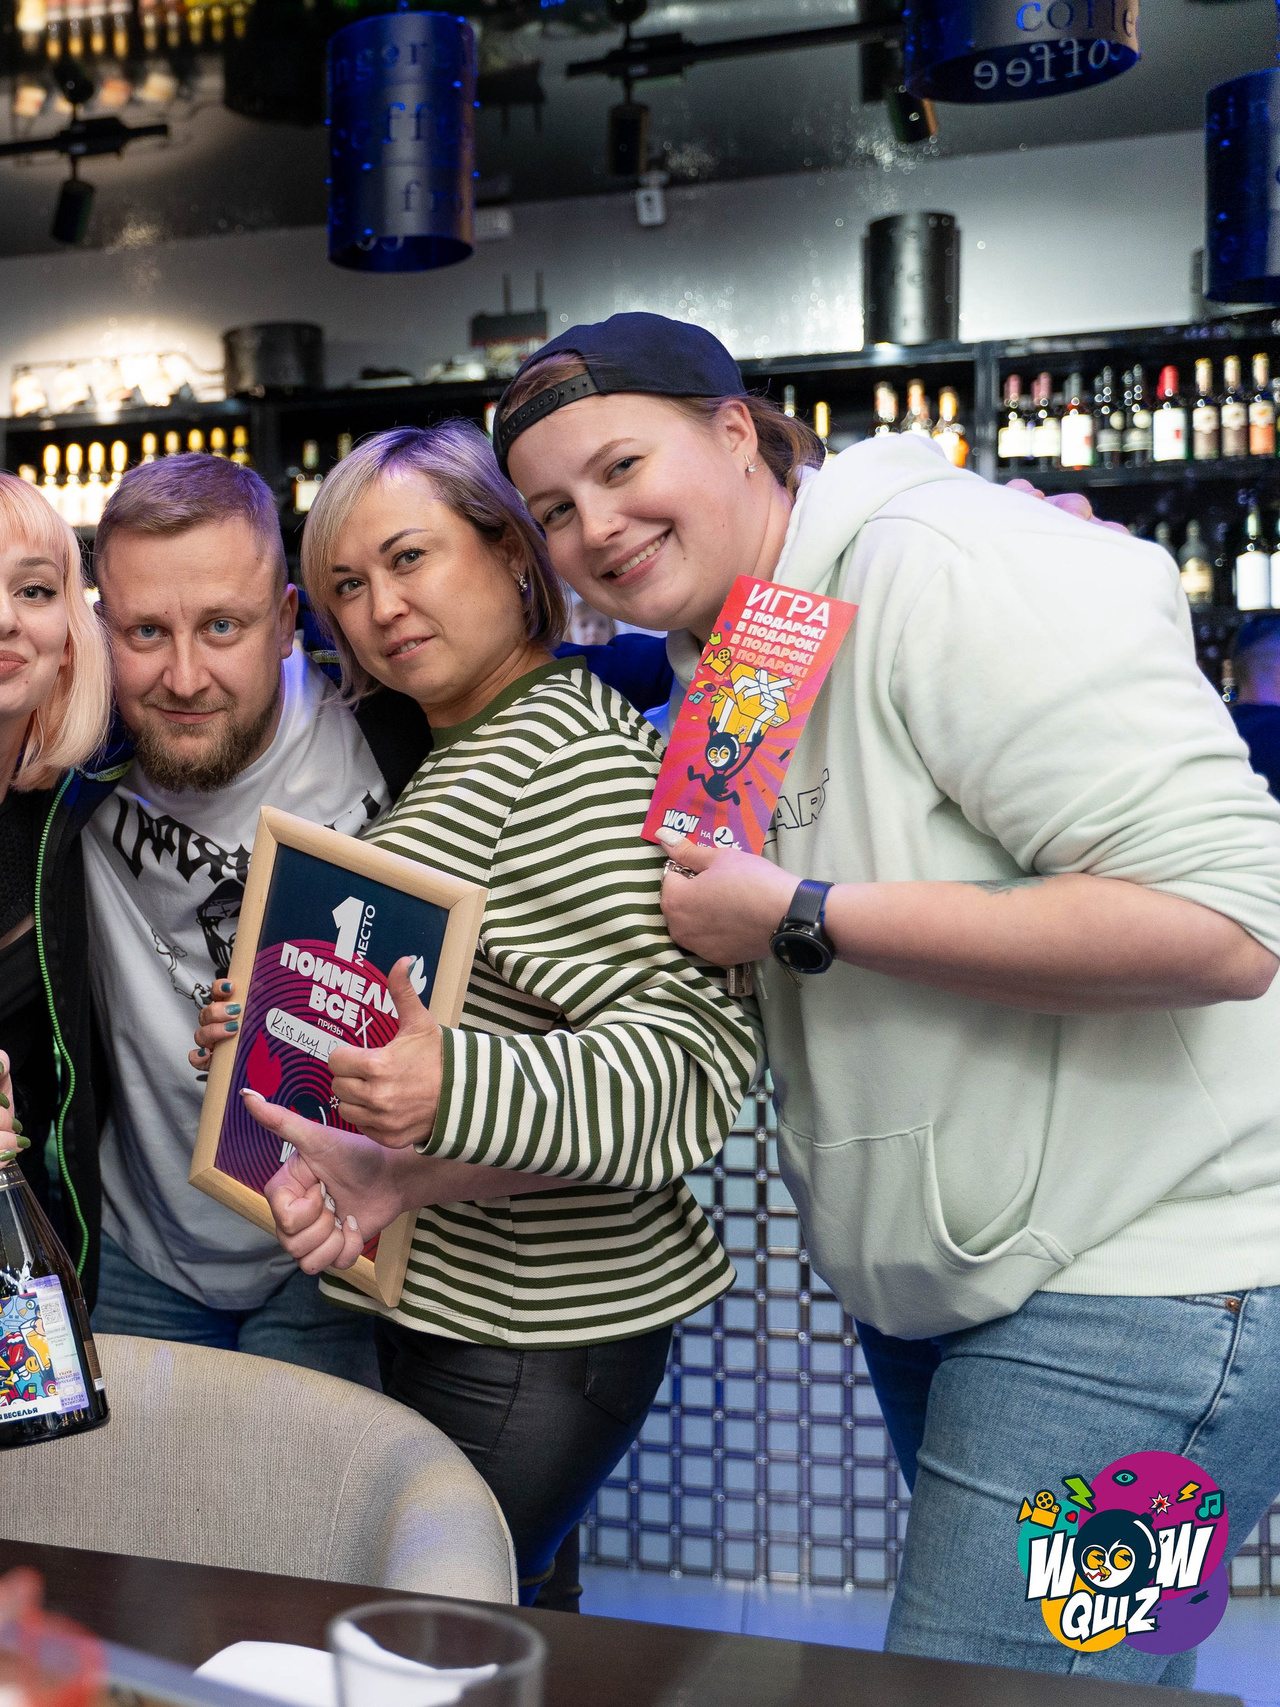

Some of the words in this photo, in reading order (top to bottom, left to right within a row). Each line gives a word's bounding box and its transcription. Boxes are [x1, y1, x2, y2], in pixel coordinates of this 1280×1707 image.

[745, 584, 830, 628] ИГРА
[735, 621, 747, 632] В
[747, 624, 820, 653] ПОДАРОК!
[741, 608, 753, 619] В
[752, 611, 827, 640] ПОДАРОК!
[730, 634, 741, 645] В
[741, 636, 815, 665] ПОДАРОК!
[736, 648, 808, 678] ПОДАРОК!
[662, 809, 701, 834] WOW
[700, 830, 711, 839] НА
[332, 896, 365, 963] 1
[354, 904, 376, 967] МЕСТО
[317, 1018, 343, 1036] ПРИЗЫ
[3, 1407, 38, 1420] ВЕСЕЛЬЯ
